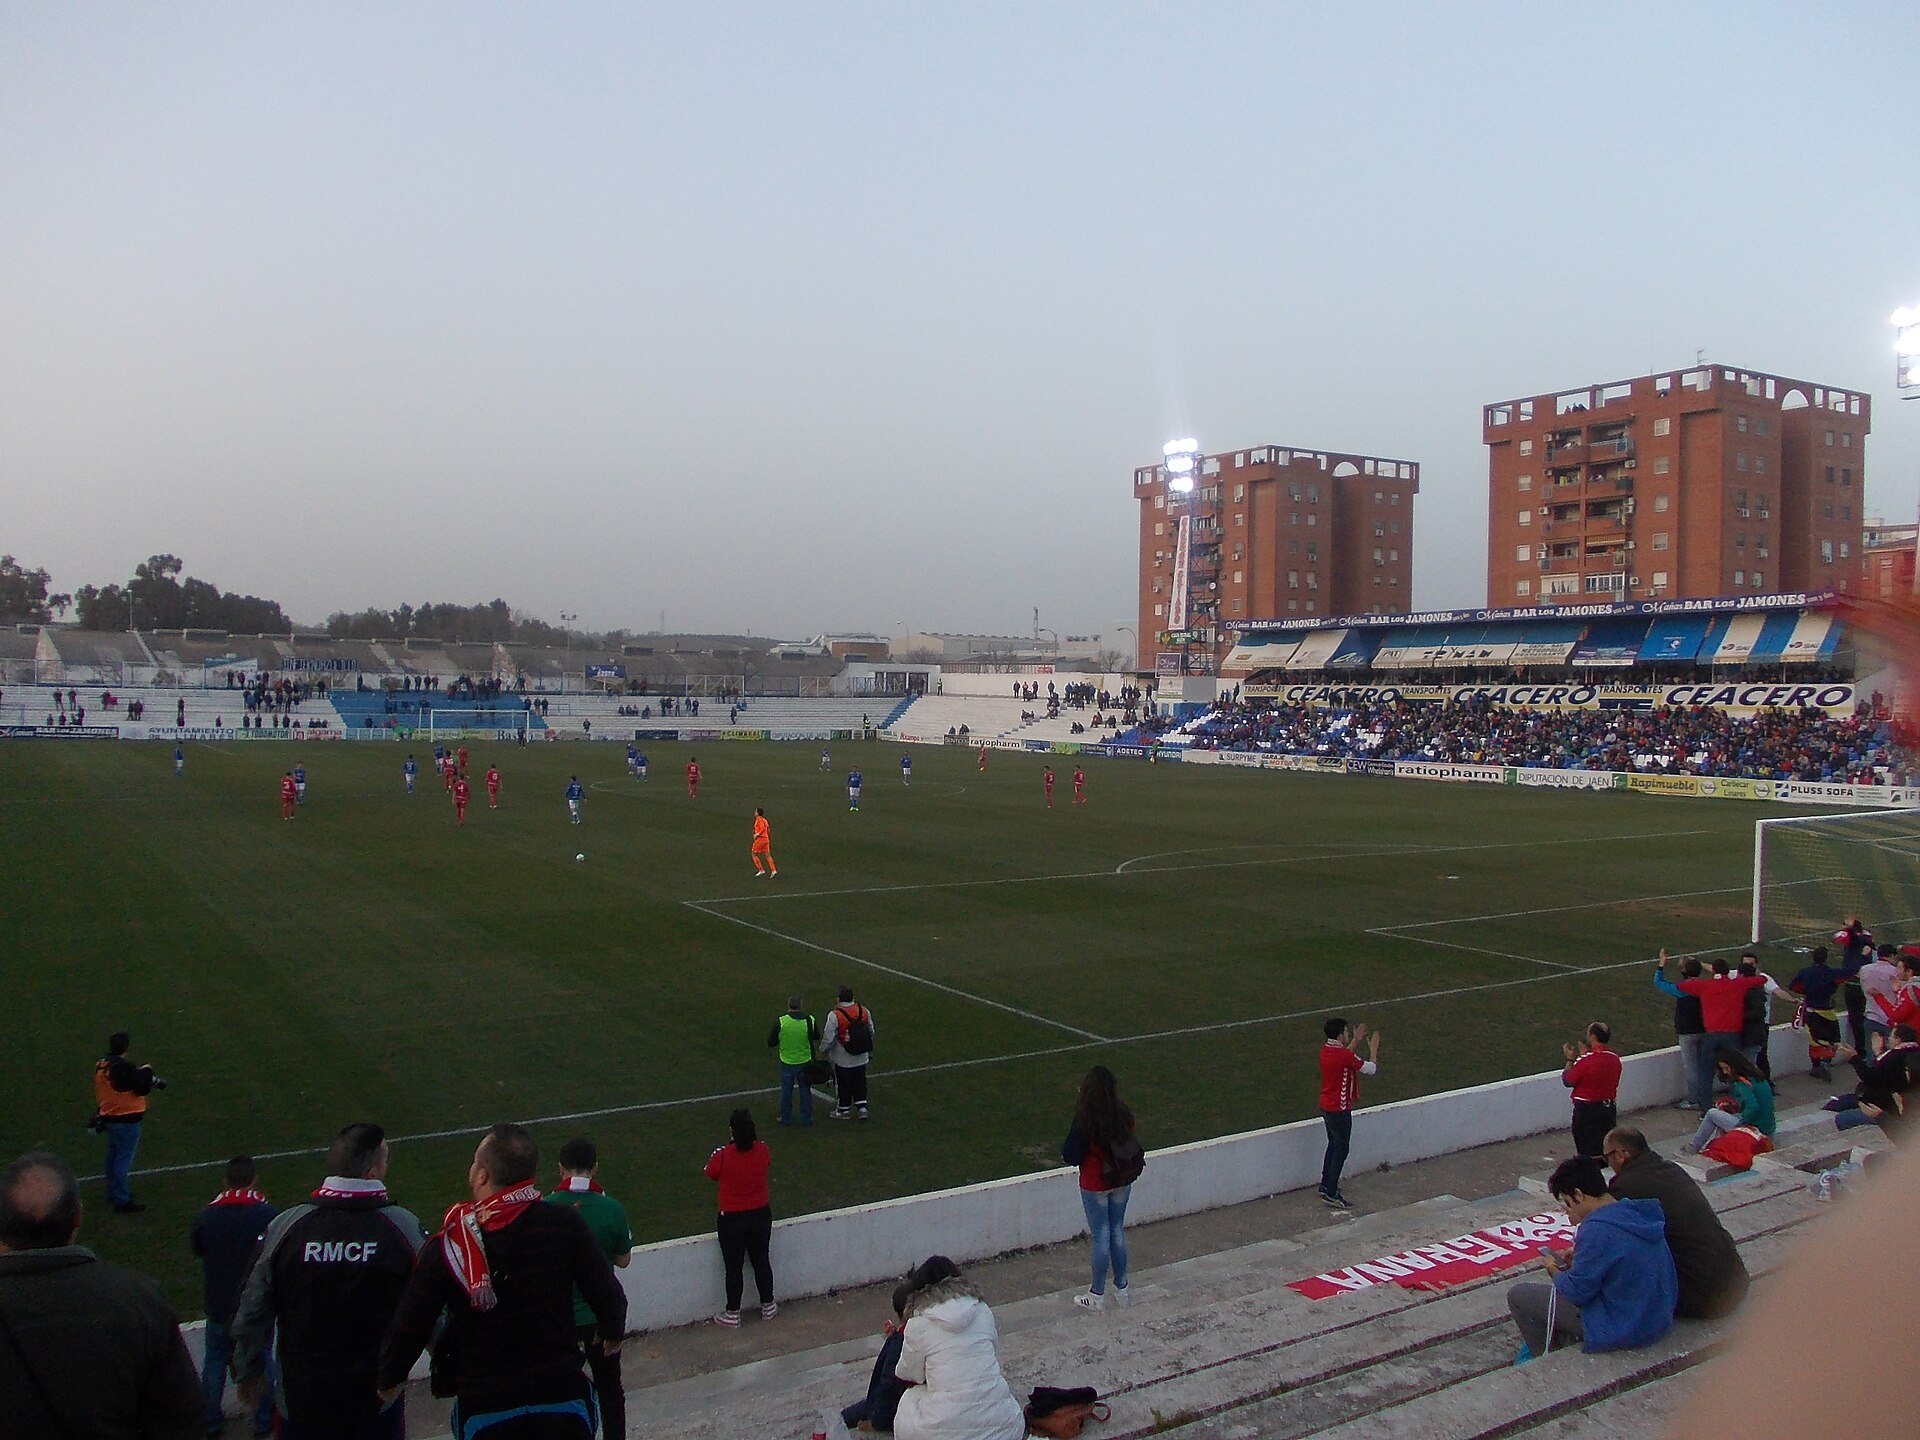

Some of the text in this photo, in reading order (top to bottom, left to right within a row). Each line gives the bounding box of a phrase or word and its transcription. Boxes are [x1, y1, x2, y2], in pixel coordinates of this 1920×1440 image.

[1684, 600, 1713, 610] BAR
[1715, 600, 1735, 608] LOS
[1736, 594, 1806, 608] JAMONES
[1512, 608, 1537, 618] BAR
[1538, 608, 1555, 616] LOS
[1555, 605, 1613, 616] JAMONES
[1281, 618, 1321, 629] JAMONES
[1370, 616, 1390, 624] BAR
[1405, 612, 1453, 624] JAMONES
[1454, 687, 1597, 705] CEACERO
[1599, 685, 1853, 707] TRANSPOTES CEACERO
[70, 727, 117, 735] JAMONES
[148, 727, 234, 735] AYUNTAMIENTO
[970, 739, 1020, 748] ratiopharm
[1226, 753, 1257, 763] SURPYME
[1398, 766, 1499, 780] ratiopharm
[1572, 776, 1584, 785] DE
[1630, 777, 1695, 791] Rapimueble
[1791, 785, 1823, 795] PLUSS
[1826, 787, 1854, 797] SOFA
[1904, 790, 1920, 800] IF
[303, 1241, 379, 1263] RMCF
[1317, 1233, 1513, 1292] GRANA
